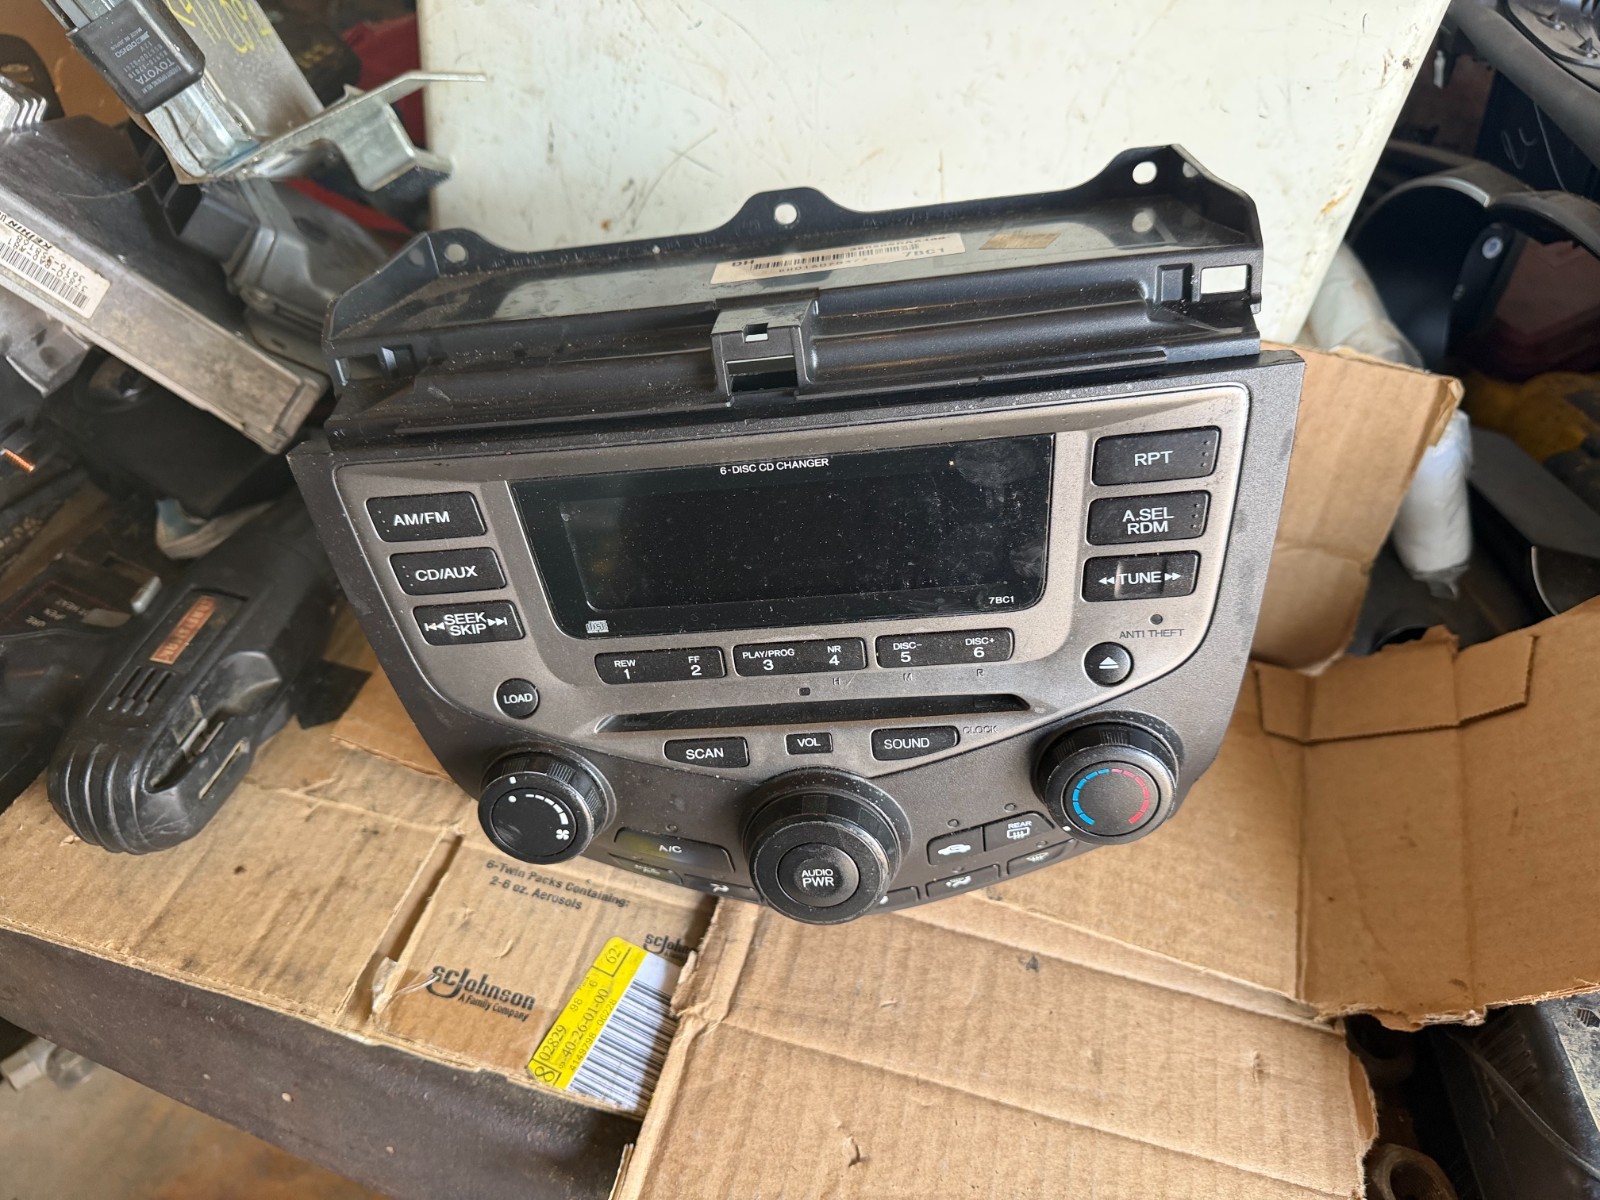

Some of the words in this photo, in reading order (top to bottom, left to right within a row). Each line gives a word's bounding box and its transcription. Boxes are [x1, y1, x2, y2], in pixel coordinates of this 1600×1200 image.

[135, 58, 176, 86] TOYOTA
[6, 219, 53, 251] KEIHIN
[1134, 451, 1173, 466] RPT
[720, 464, 757, 476] 6-DISC
[758, 463, 775, 472] CD
[777, 458, 829, 471] CHANGER
[393, 511, 450, 527] AM/FM
[1122, 507, 1174, 522] A.SEL
[1127, 521, 1169, 535] RDM
[415, 565, 478, 582] CD/AUX
[1119, 571, 1162, 585] TUNE
[988, 595, 1014, 604] 7BC1
[443, 611, 487, 625] SEEK
[449, 623, 487, 637] SKIP
[1119, 629, 1145, 639] ANTI
[1147, 628, 1185, 638] THEFT
[965, 637, 995, 646] DISC+
[742, 648, 795, 659] PLAY/PROG
[827, 645, 841, 653] NR
[973, 646, 985, 658] 6
[688, 655, 700, 664] FF
[828, 655, 840, 666] 4
[900, 651, 911, 663] 5
[613, 659, 636, 668] REW
[763, 659, 774, 671] 3
[623, 668, 631, 680] 1
[690, 665, 702, 676] 2
[976, 668, 984, 677] R
[832, 677, 841, 686] H
[902, 672, 913, 682] M
[503, 692, 533, 704] LOAD
[962, 725, 998, 734] CLOCK
[797, 737, 821, 747] VOL
[883, 737, 930, 749] SOUND
[686, 748, 724, 759] SCAN
[1007, 820, 1032, 829] REAR
[659, 844, 682, 853] A/C
[801, 868, 834, 879] AUDIO
[486, 859, 526, 879] 6-Twin
[528, 871, 564, 889] Packs
[565, 881, 631, 909] Containing:
[802, 876, 835, 888] PWR
[512, 884, 529, 896] oz.
[531, 888, 583, 910] Aerosols
[605, 946, 622, 964] 62
[589, 979, 598, 989] 6
[458, 992, 465, 1002] A
[466, 994, 493, 1011] Family
[492, 1002, 530, 1022] Company
[569, 997, 583, 1013] 98
[596, 998, 617, 1026] 06228
[538, 1024, 567, 1062] 02829
